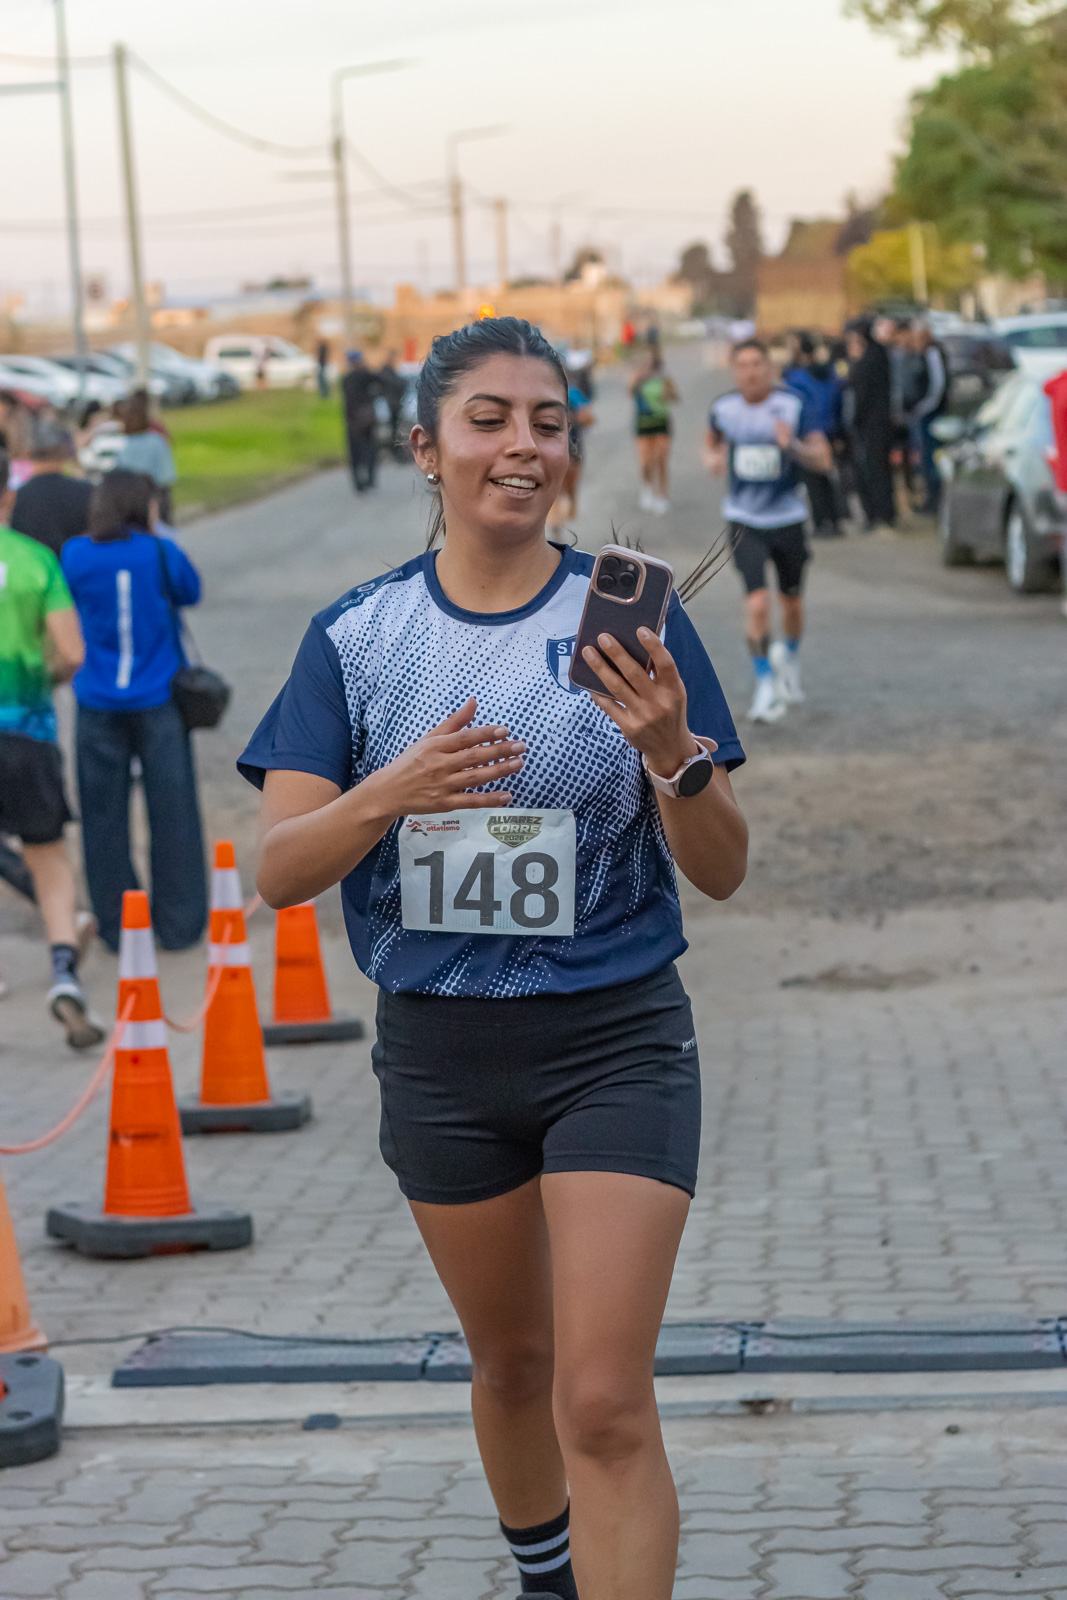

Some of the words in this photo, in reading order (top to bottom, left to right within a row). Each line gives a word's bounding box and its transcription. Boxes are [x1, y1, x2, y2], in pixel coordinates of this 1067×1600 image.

[489, 816, 543, 824] ALVAREZ
[490, 824, 541, 834] CORRE
[414, 851, 560, 928] 148
